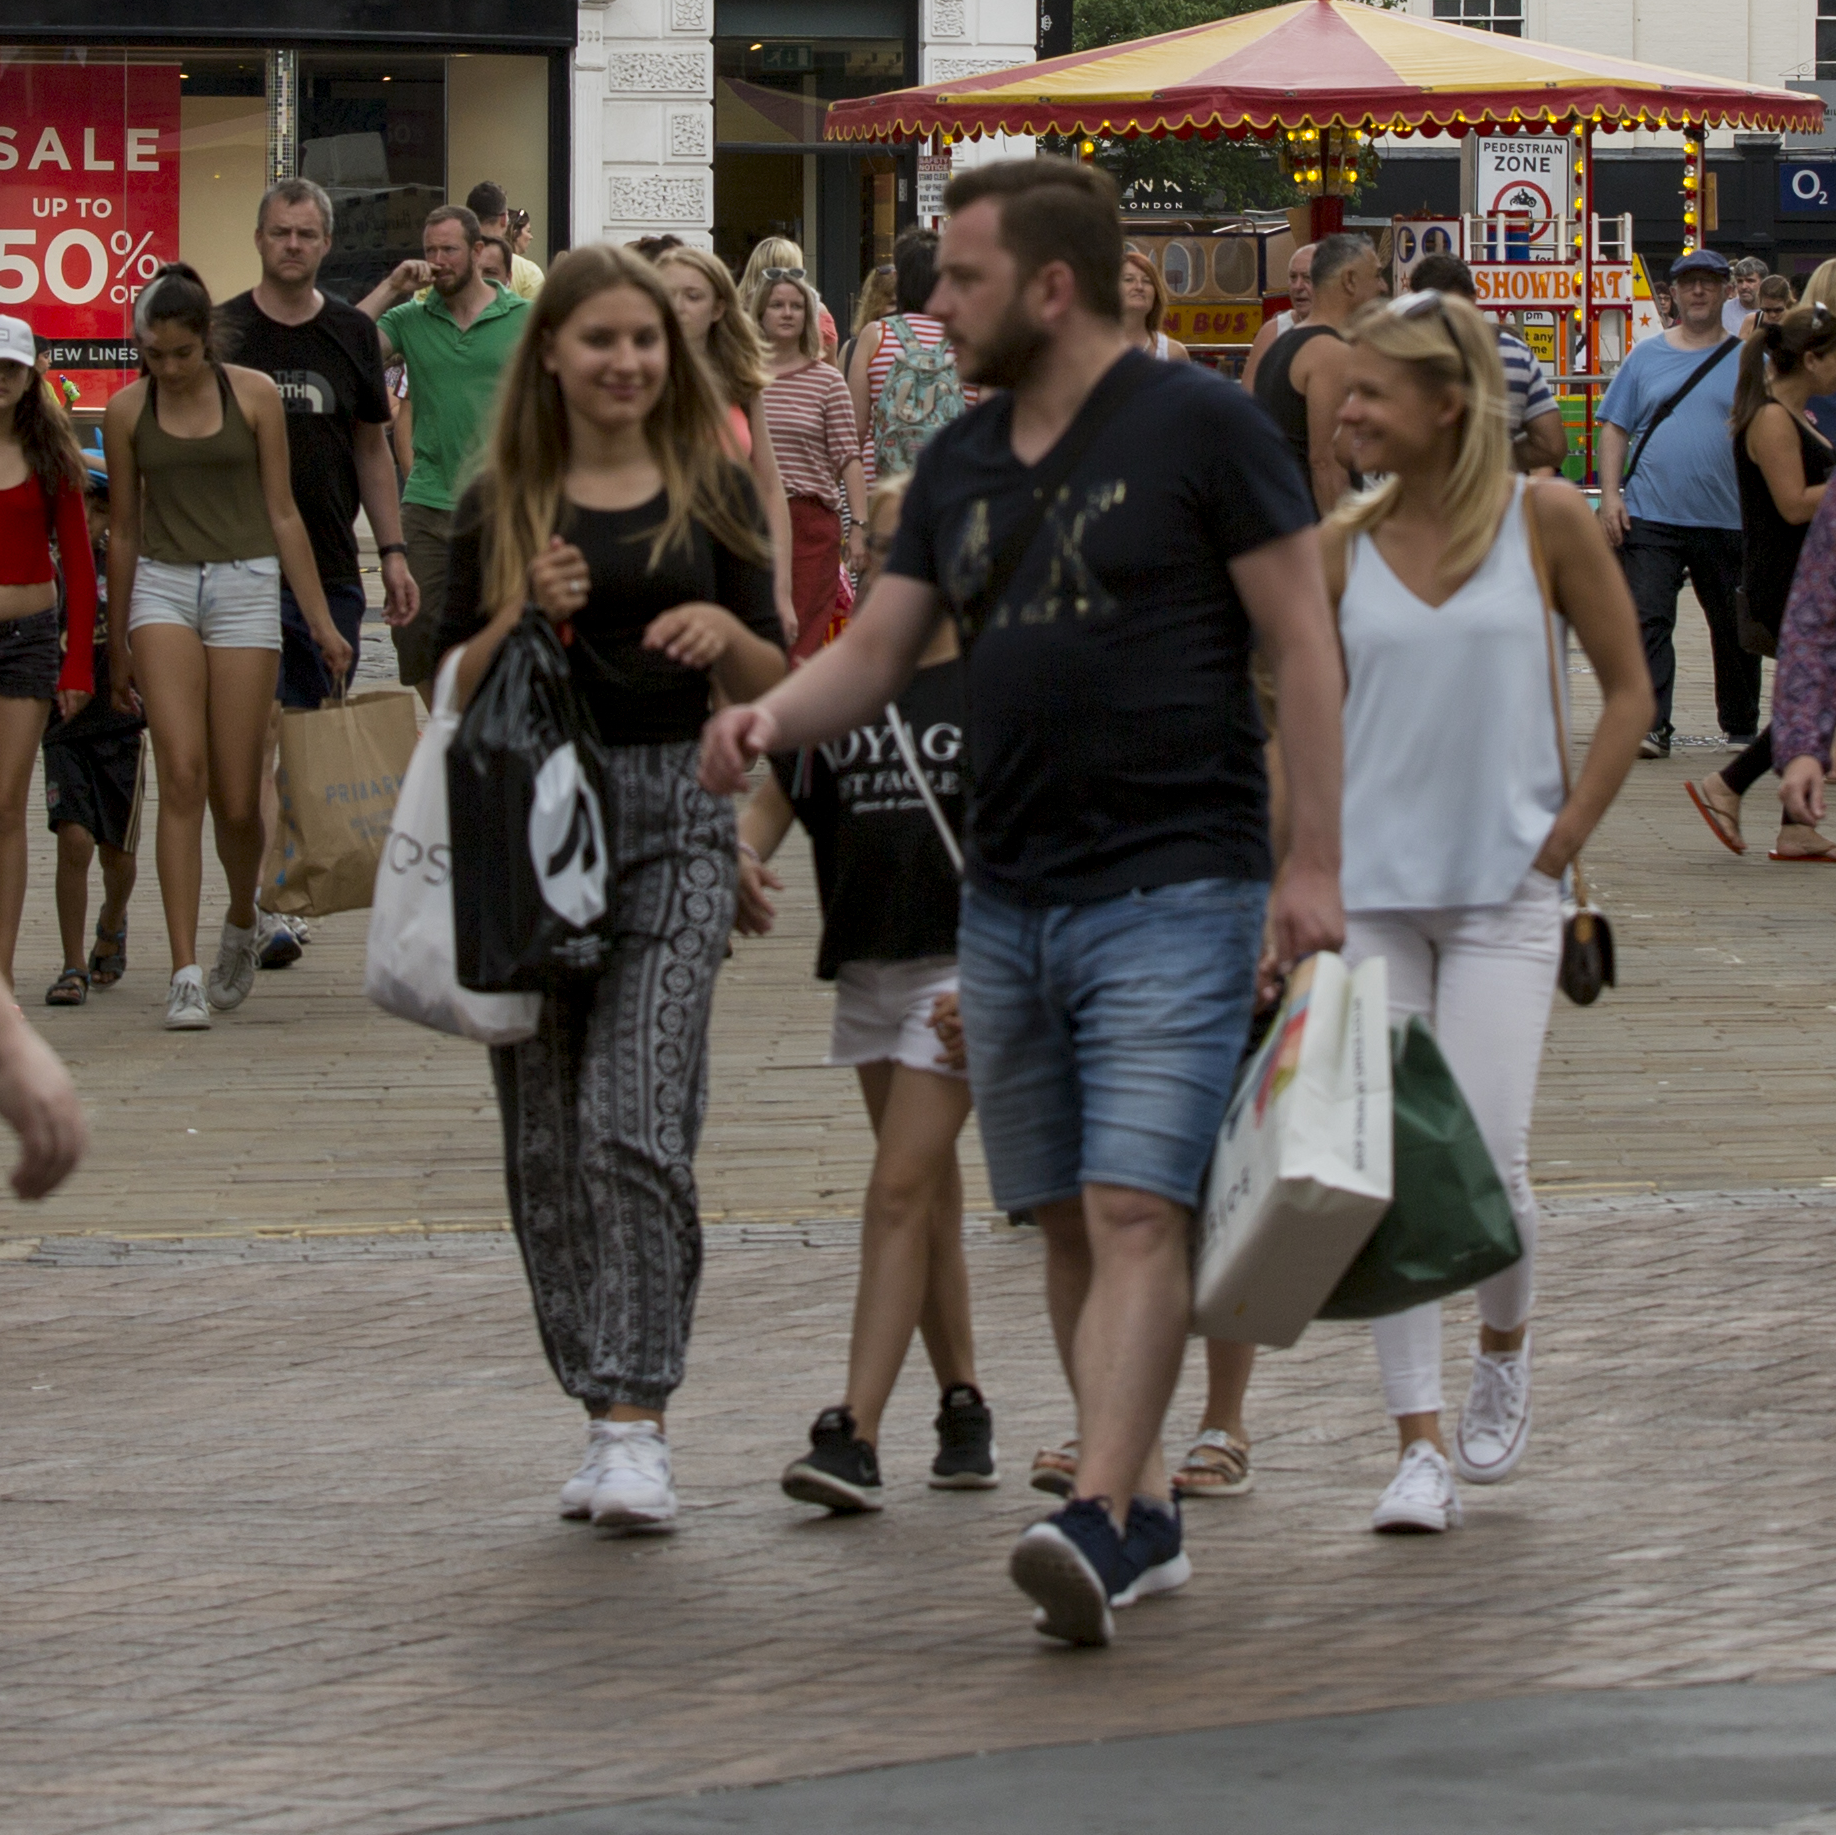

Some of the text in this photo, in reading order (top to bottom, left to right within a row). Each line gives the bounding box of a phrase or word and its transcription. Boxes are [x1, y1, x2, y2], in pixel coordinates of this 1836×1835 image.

[1483, 142, 1563, 154] PEDESTRIAN
[1494, 156, 1551, 172] ZONE
[32, 198, 113, 218] UP TO
[110, 285, 144, 304] OF
[1193, 313, 1248, 334] BUS
[1534, 332, 1554, 344] any
[89, 348, 139, 361] LINES
